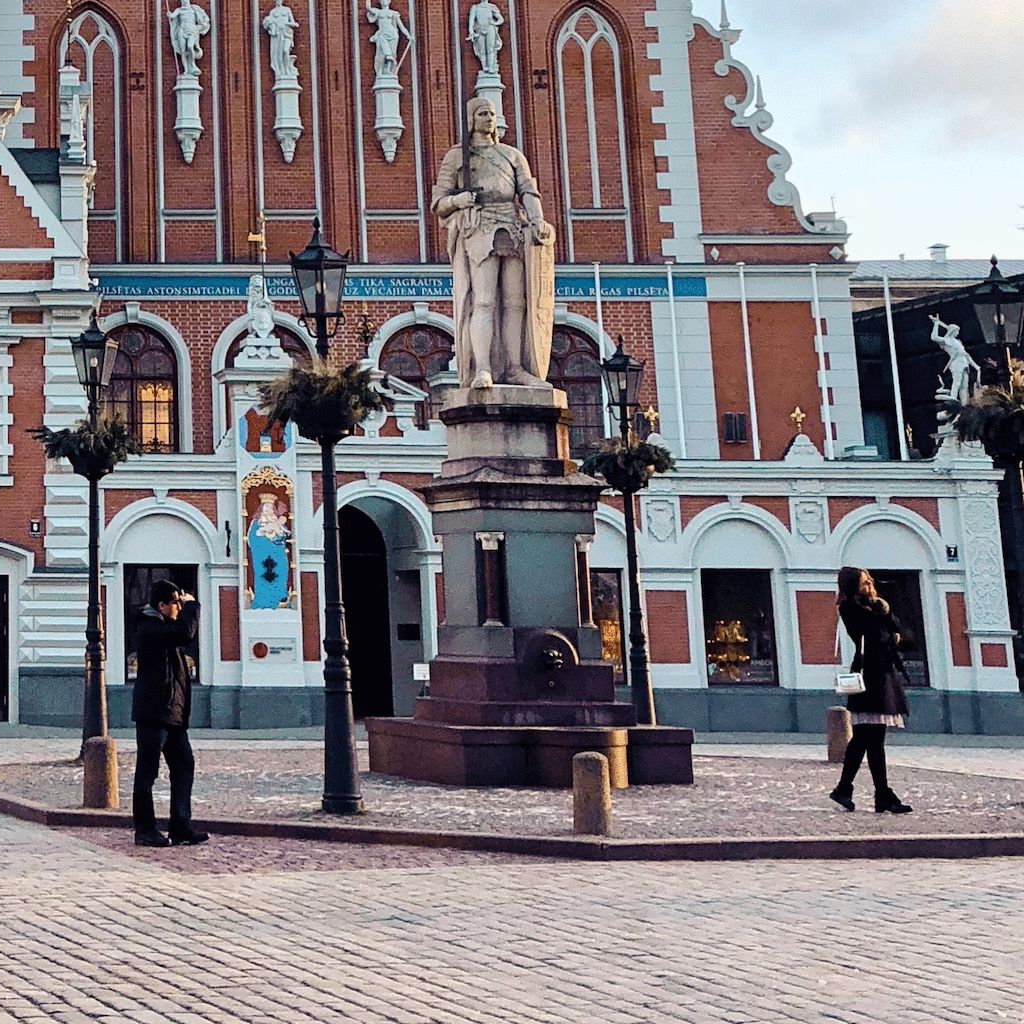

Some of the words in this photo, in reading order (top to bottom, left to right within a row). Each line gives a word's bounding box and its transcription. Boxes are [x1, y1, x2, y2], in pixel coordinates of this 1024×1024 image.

[267, 277, 295, 287] LNGA
[360, 278, 385, 287] TIKA
[390, 277, 443, 287] SAGRAUTS
[344, 287, 358, 296] UZ
[422, 287, 454, 296] PAMAT
[588, 287, 622, 296] RGAS
[950, 548, 955, 556] 7
